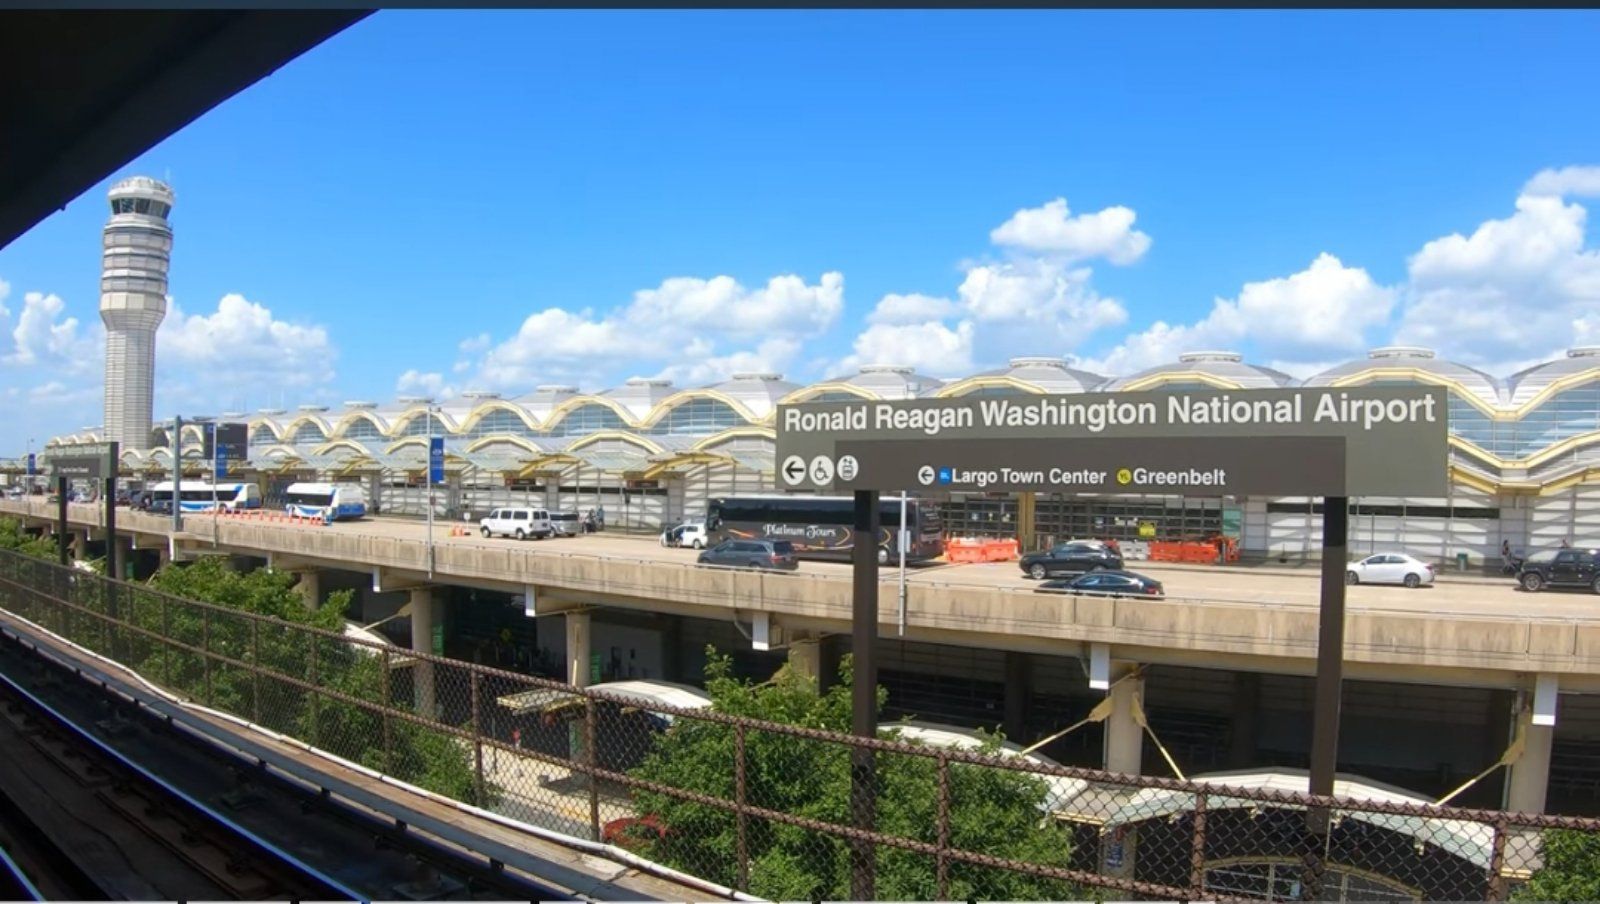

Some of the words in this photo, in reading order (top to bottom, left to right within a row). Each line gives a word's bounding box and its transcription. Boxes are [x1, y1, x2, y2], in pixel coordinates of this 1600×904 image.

[784, 405, 868, 432] Ronald
[875, 404, 973, 435] Reagan
[980, 398, 1157, 432] Washington
[1168, 394, 1301, 424] National
[1313, 393, 1436, 430] Airport
[951, 467, 998, 487] Largo
[1001, 467, 1044, 484] Town
[1049, 467, 1107, 484] Center
[1133, 467, 1226, 486] Greenbelt
[762, 523, 805, 537] Platinum
[806, 525, 837, 539] Tours
